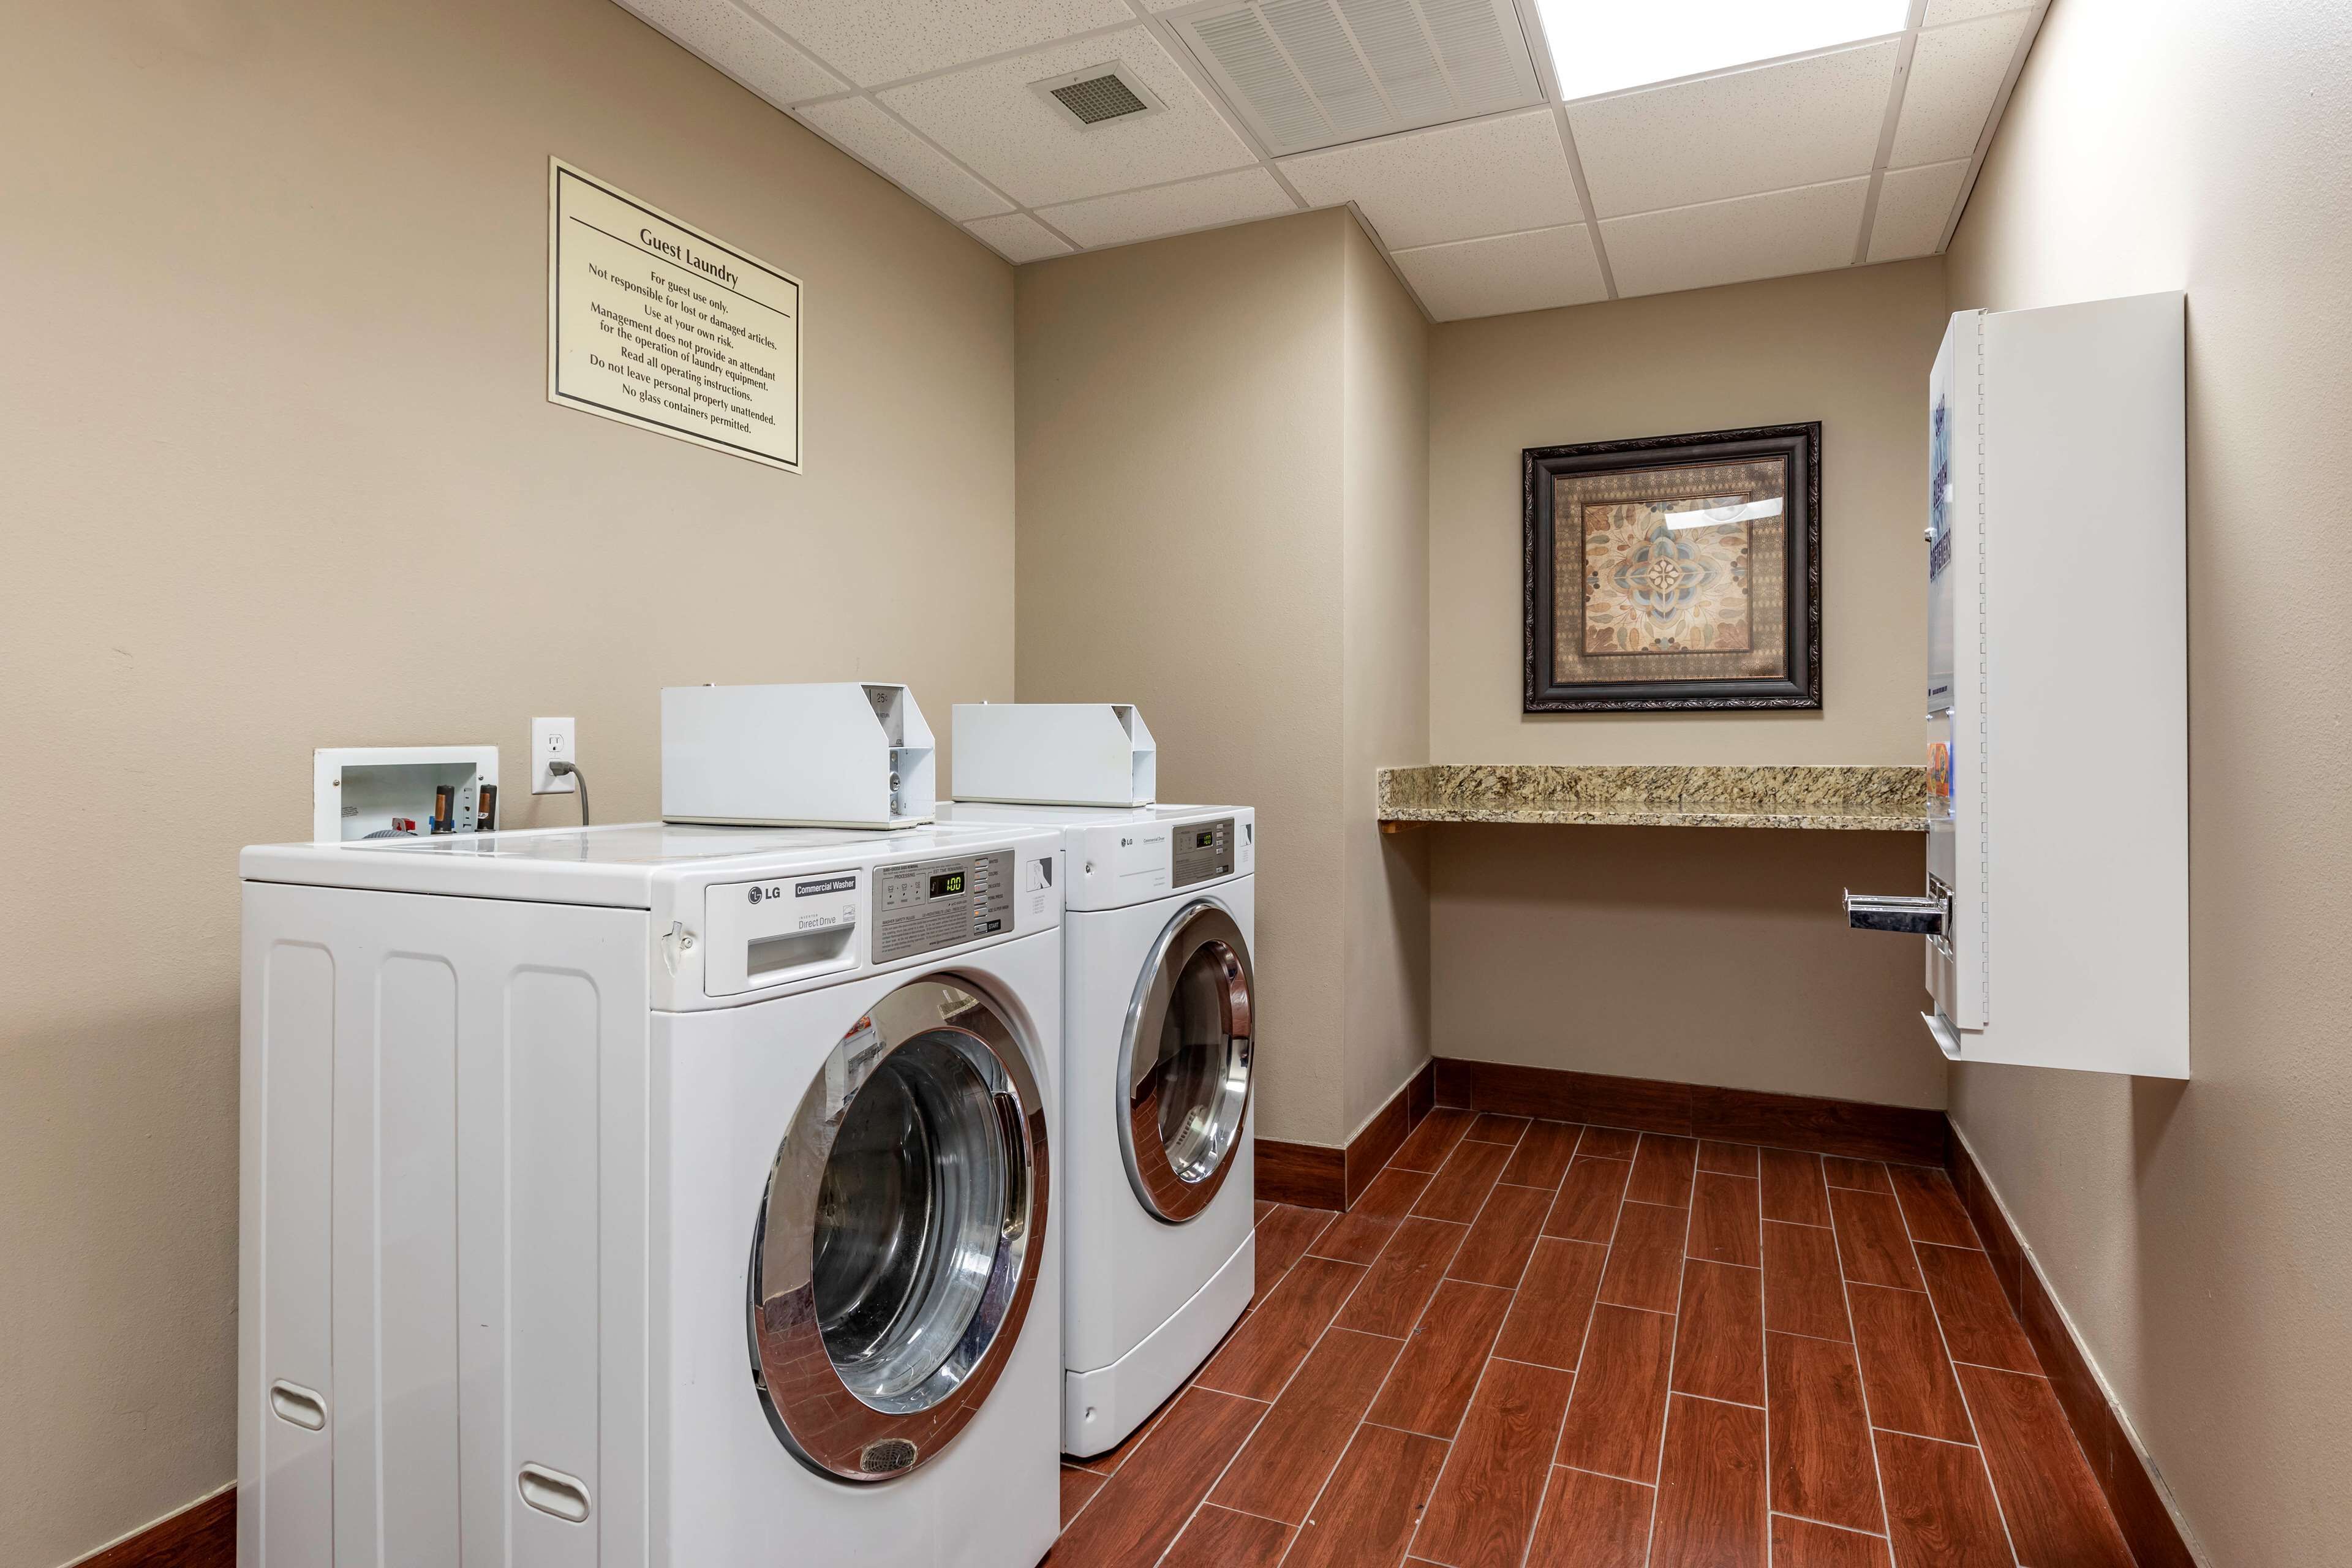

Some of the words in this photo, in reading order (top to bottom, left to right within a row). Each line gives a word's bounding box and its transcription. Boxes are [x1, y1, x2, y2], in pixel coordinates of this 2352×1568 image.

[641, 229, 682, 260] Guest
[687, 249, 738, 289] Laundry
[589, 263, 608, 279] Not
[611, 274, 663, 303] responsible
[666, 295, 678, 309] for
[681, 301, 696, 317] lost
[699, 312, 707, 321] or
[710, 315, 745, 337] damaged
[748, 333, 777, 350] articles.
[651, 271, 665, 285] For
[668, 282, 690, 297] guest
[693, 293, 707, 304] use
[709, 300, 728, 315] only.
[590, 301, 652, 334] Management
[655, 326, 676, 343] does
[678, 337, 692, 350] not
[695, 345, 726, 362] provide
[728, 357, 737, 366] an
[740, 361, 775, 381] attendant
[645, 304, 662, 320] Use
[664, 315, 673, 325] at
[675, 319, 695, 333] your
[697, 328, 714, 341] own
[717, 334, 734, 349] risk.
[600, 320, 614, 333] for
[617, 326, 632, 341] the
[635, 336, 677, 358] operation
[680, 352, 691, 362] of
[693, 356, 723, 376] laundry
[725, 370, 769, 391] equipment.
[621, 346, 644, 363] Read
[647, 356, 658, 368] all
[661, 364, 701, 386] operating
[704, 375, 752, 401] instructions.
[590, 353, 605, 368] Do
[608, 363, 624, 375] not
[627, 366, 651, 383] leave
[654, 378, 691, 397] personal
[693, 392, 728, 412] property
[731, 405, 775, 425] unattended.
[622, 383, 636, 396] No
[639, 390, 661, 404] glass
[663, 400, 708, 420] containers
[710, 415, 752, 434] permitted.
[766, 887, 780, 899] LG
[797, 883, 832, 894] Commercial
[832, 880, 854, 890] Washer
[799, 919, 819, 929] Direct
[820, 916, 836, 925] Drive
